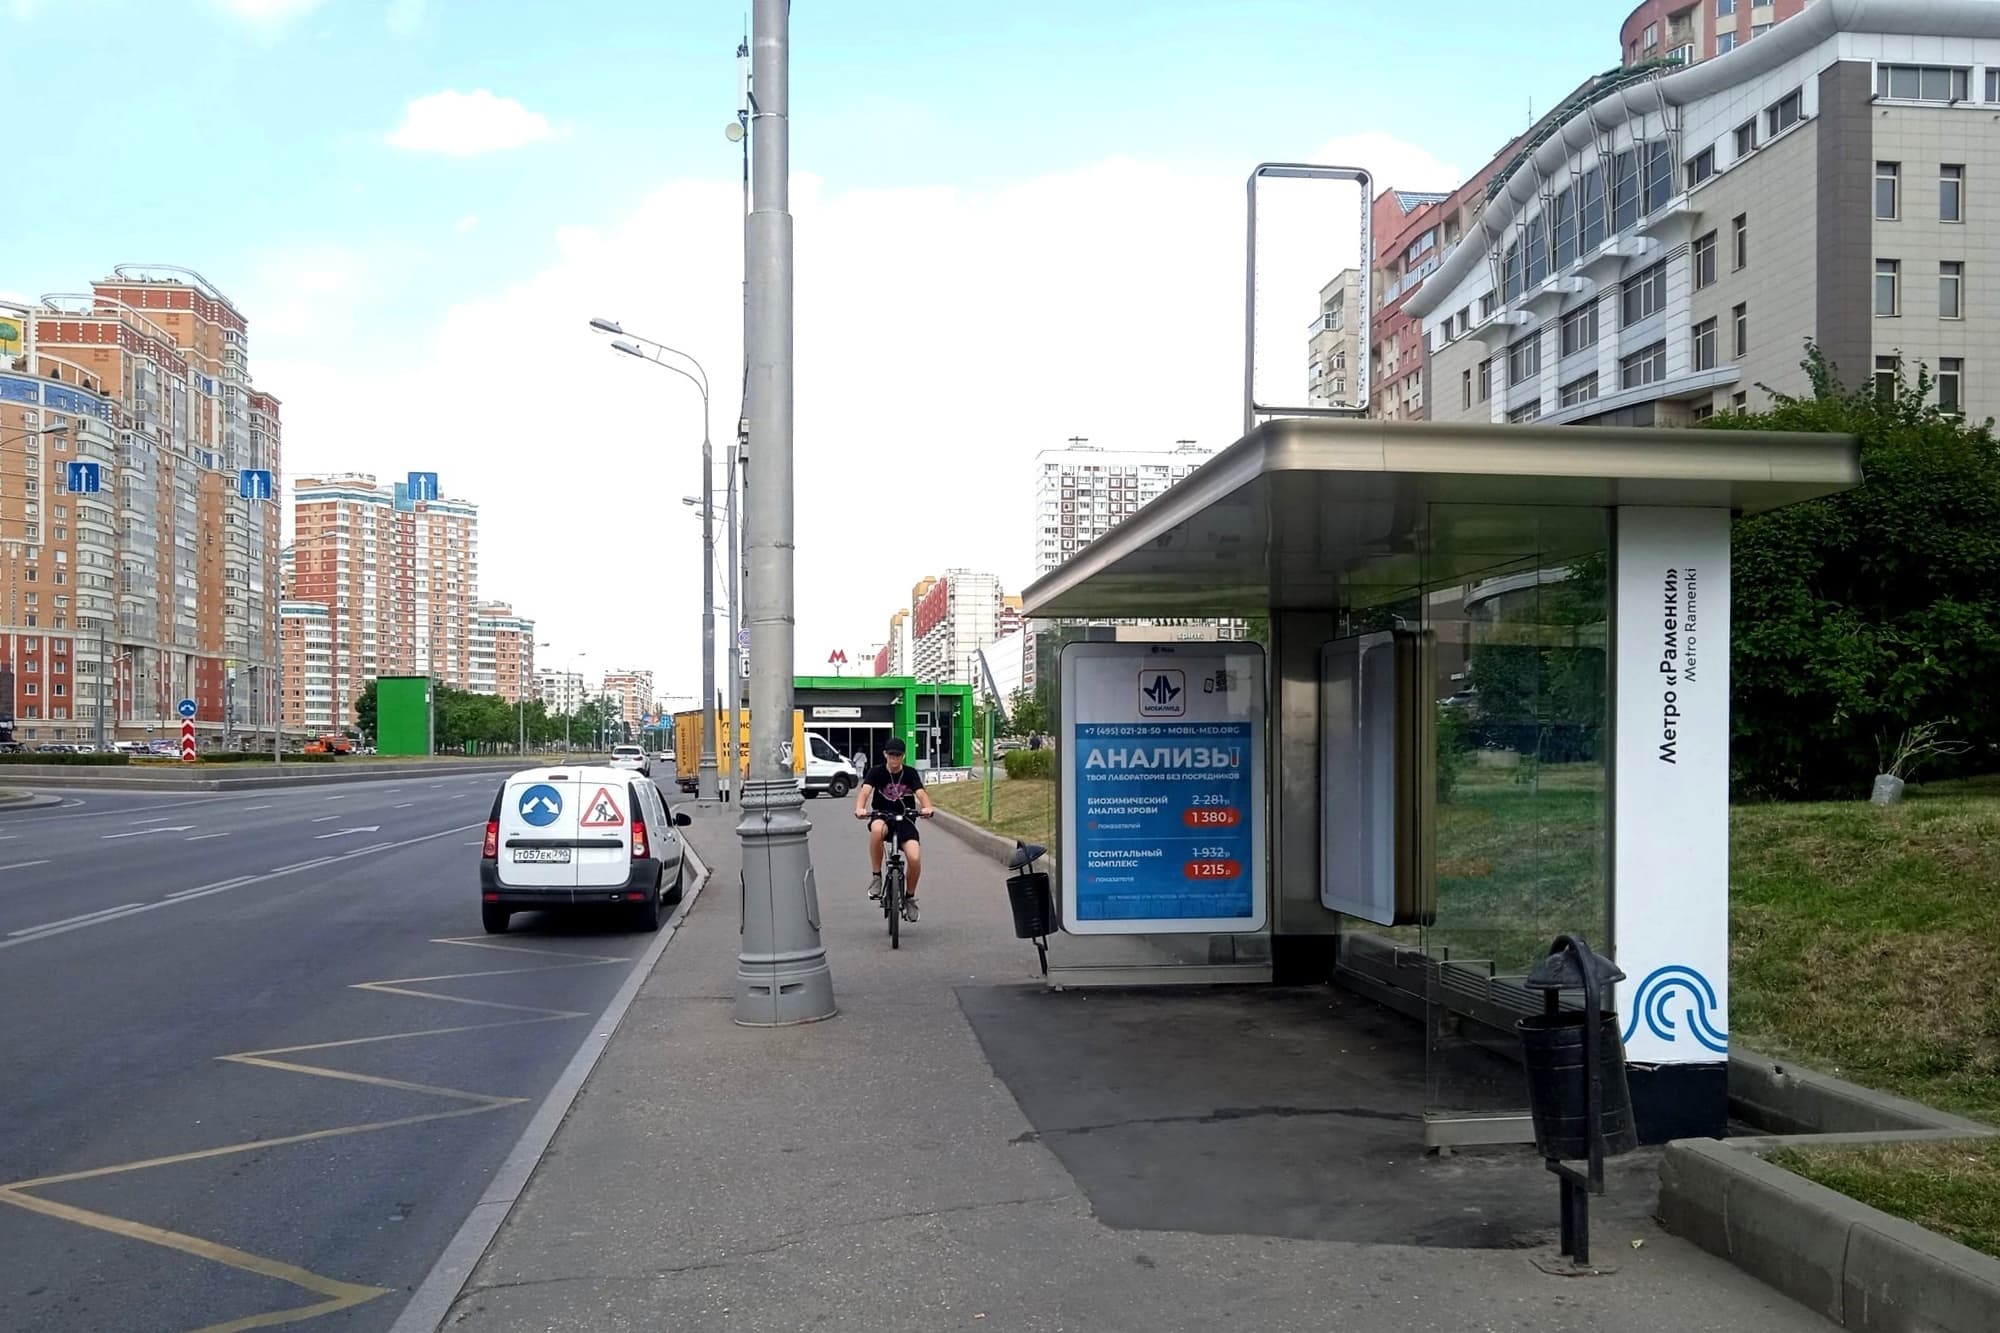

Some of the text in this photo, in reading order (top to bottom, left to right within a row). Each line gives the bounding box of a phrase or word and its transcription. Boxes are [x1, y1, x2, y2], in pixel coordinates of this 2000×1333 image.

[1684, 568, 1697, 682] Metro Ramenki
[1659, 568, 1681, 765] Метро «Раменки»
[1096, 727, 1119, 736] (495)
[1168, 726, 1240, 735] MOBIL-MED.ORG
[1086, 773, 1240, 782] ТВОЯ ЛАБОРАТОРИЯ БЕЗ ПОСРЕДНИКОВ
[1087, 795, 1169, 805] БИОХИМИЧЕСКИЙ
[1087, 807, 1126, 815] АНАЛИЗ
[1088, 848, 1163, 858] ГОСПИТАЛЬНЫЙ
[1088, 860, 1139, 868] КОМПЛЕКС
